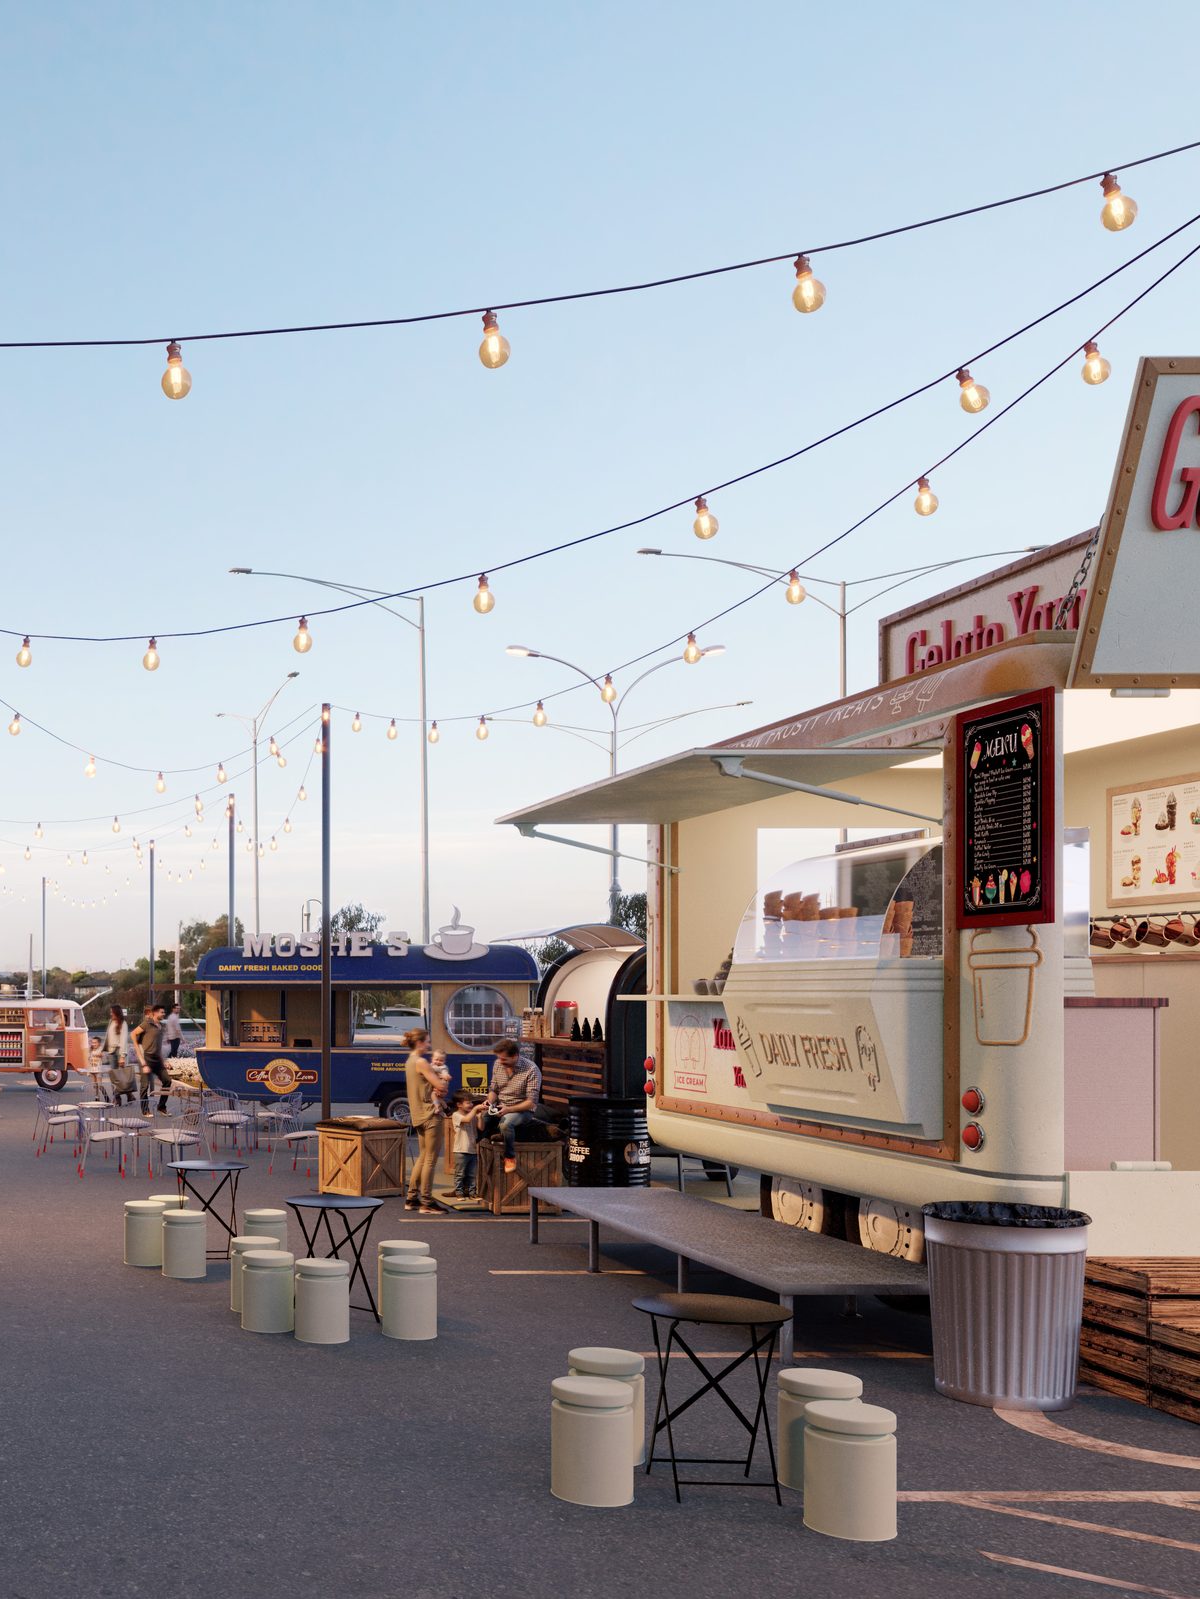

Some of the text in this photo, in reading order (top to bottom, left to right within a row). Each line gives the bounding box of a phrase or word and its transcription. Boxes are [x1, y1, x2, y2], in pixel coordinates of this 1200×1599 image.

[981, 733, 1018, 761] MENU
[241, 930, 409, 958] MOSHE'S
[218, 964, 323, 972] DAIRY FRESH BAKED GOOD
[759, 1031, 853, 1073] DAILY FRESH
[676, 1076, 704, 1086] ICE CREAM
[569, 1146, 590, 1155] COFFEE
